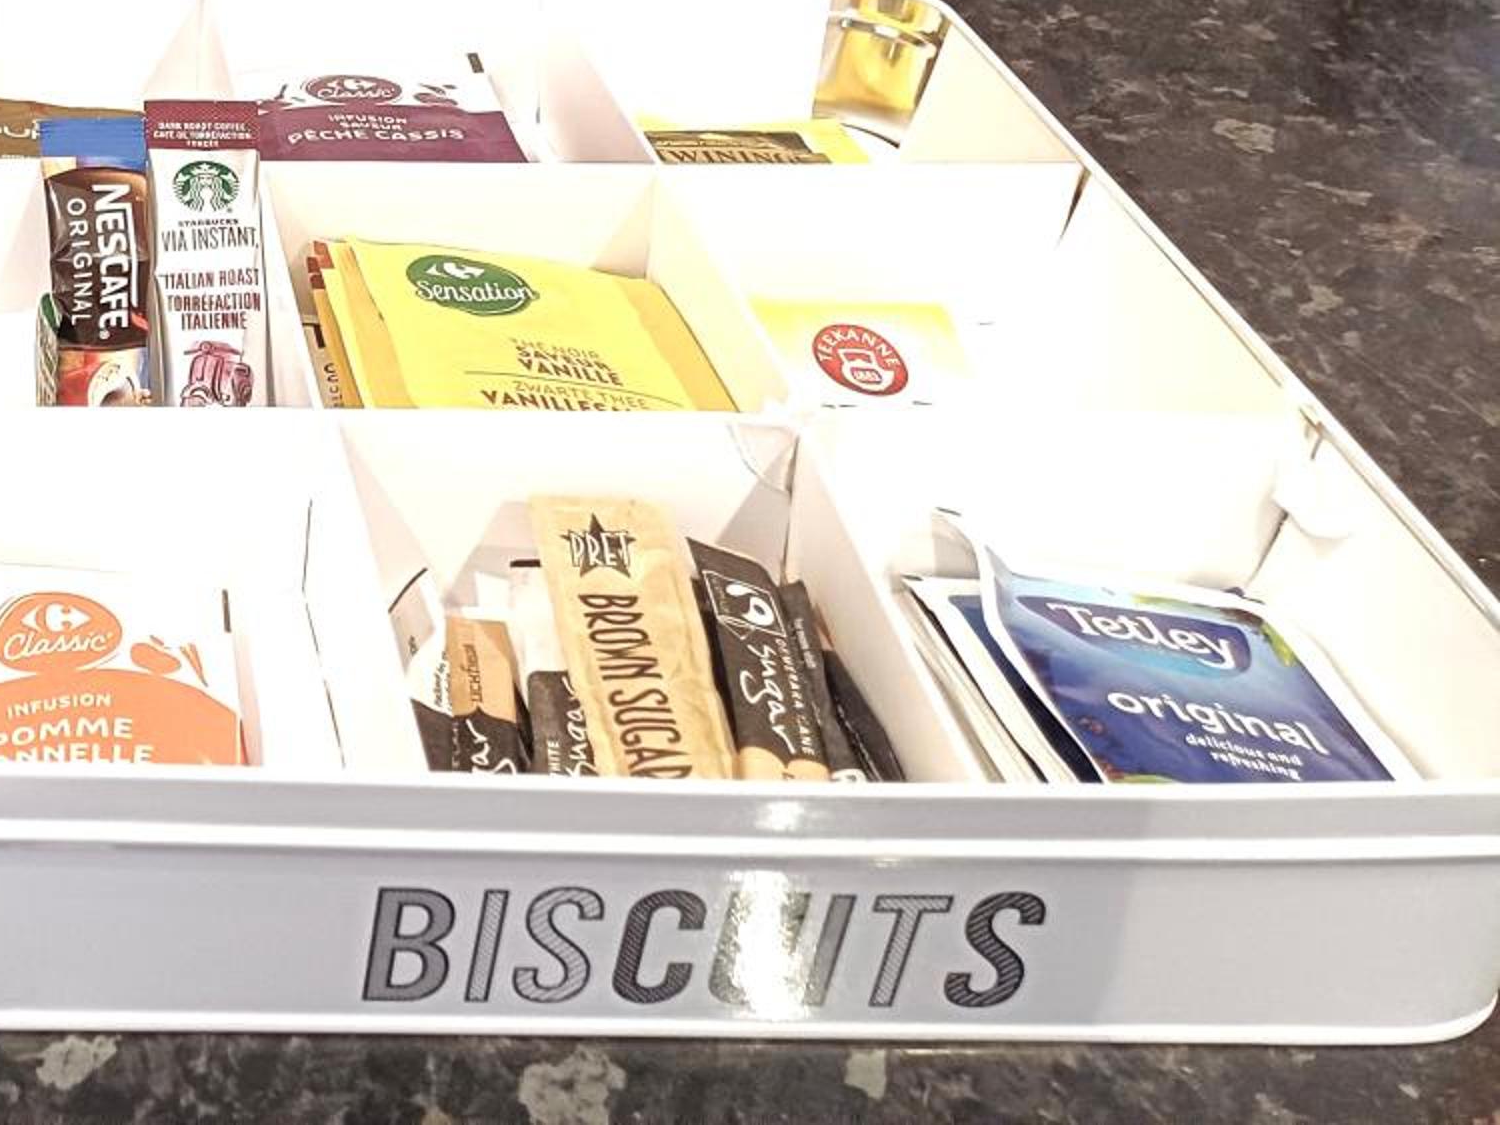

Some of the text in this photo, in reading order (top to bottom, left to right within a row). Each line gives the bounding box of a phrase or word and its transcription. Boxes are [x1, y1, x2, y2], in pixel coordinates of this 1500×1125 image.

[374, 128, 466, 142] CASSIS
[178, 218, 239, 227] STARBUCKS
[161, 229, 188, 252] VIA
[65, 197, 93, 326] ORIGINAL
[164, 267, 259, 289] ITALIAN ROAST
[415, 279, 534, 303] Sensation
[180, 312, 248, 331] ITALIENNE
[817, 328, 901, 368] TEEKANNE
[517, 357, 624, 387] VANILLE
[568, 530, 635, 568] PRET
[3, 627, 114, 662] Classic
[578, 594, 664, 682] BROWN
[1045, 602, 1237, 671] Tetley
[7, 692, 112, 720] INFUSION
[1106, 692, 1330, 756] original
[1185, 732, 1304, 767] delicious and
[362, 887, 1048, 1008] BISCUITS
